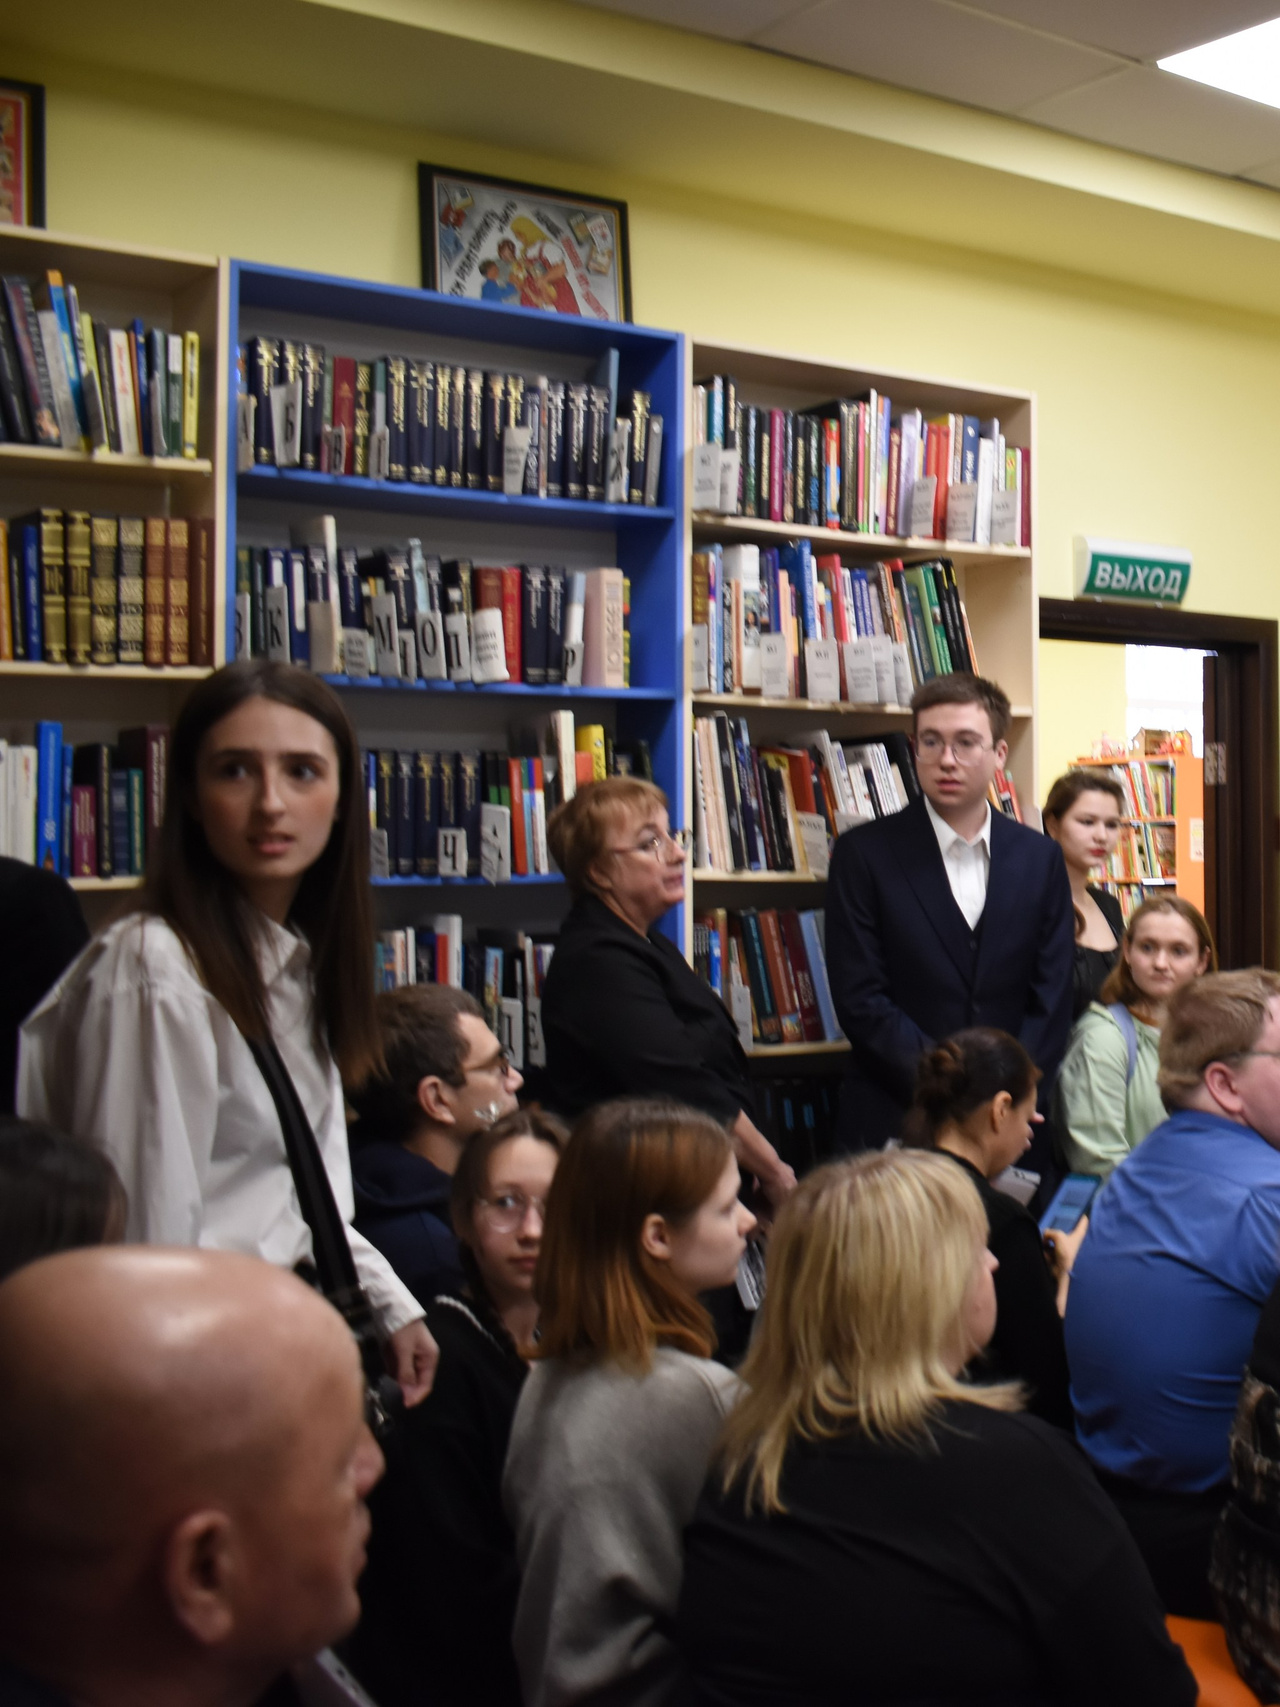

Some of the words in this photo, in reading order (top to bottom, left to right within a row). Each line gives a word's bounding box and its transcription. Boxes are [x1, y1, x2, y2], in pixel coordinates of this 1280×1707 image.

[285, 401, 295, 443] Б
[1094, 561, 1182, 600] ВЫХОД
[268, 608, 283, 648] К
[373, 615, 395, 654] М
[421, 619, 438, 658] О
[562, 649, 576, 685] Р
[443, 834, 457, 872] Ч
